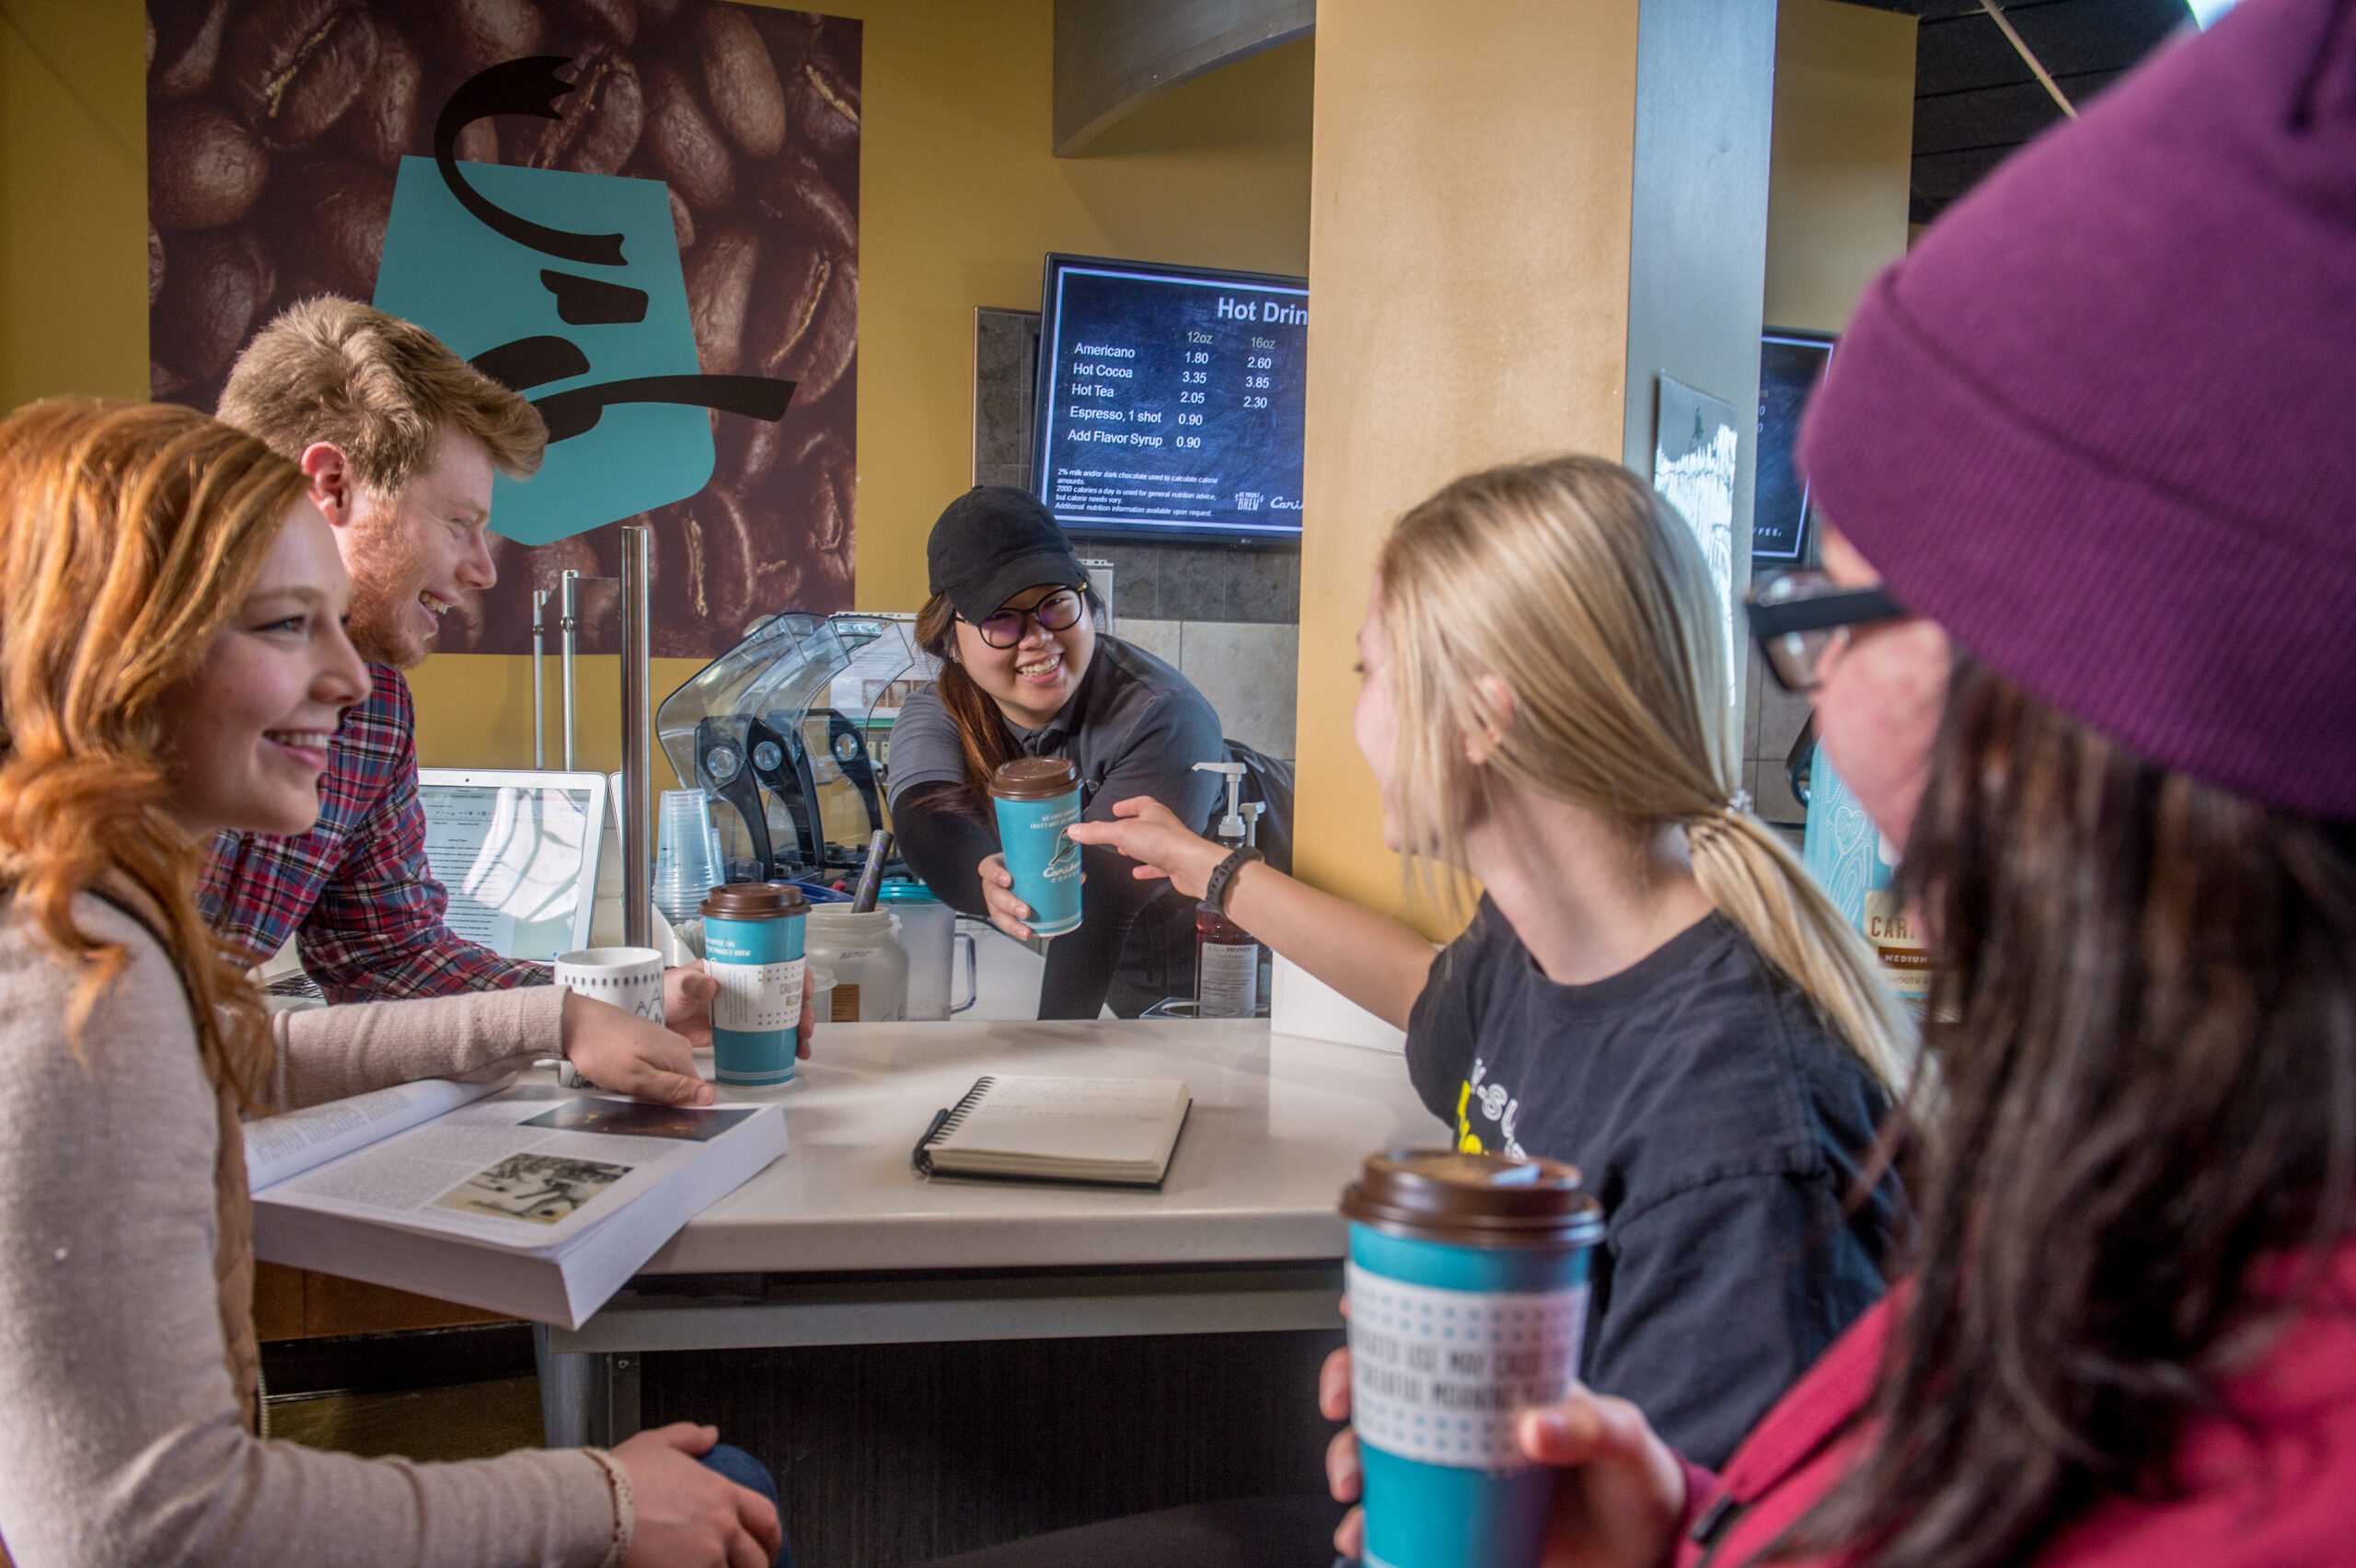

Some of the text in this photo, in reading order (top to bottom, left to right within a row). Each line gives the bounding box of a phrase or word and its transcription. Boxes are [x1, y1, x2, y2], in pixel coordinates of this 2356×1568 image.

[1217, 297, 1307, 325] Hot Drin
[1186, 331, 1276, 350] 12oz 16oz
[1074, 342, 1272, 370] Americano 1.80 2.60
[1073, 363, 1270, 389] Hot Cocoa 3.35 3.85
[1071, 384, 1268, 409] Hot Tea 2.05 2.30
[1069, 406, 1204, 426] Espresso, 1 shot 0.90
[1068, 429, 1201, 448] Add Flavor Syrup 0.90
[1057, 468, 1068, 477] 2%
[1118, 472, 1148, 481] chocolate
[1171, 475, 1197, 483] calculate
[1103, 487, 1115, 496] day
[1148, 490, 1171, 499] general
[1172, 491, 1195, 500] nutrition
[1270, 496, 1304, 510] Cari
[1055, 502, 1085, 510] Additional
[1087, 503, 1111, 512] nutrition
[1112, 504, 1145, 513] information
[1146, 506, 1172, 514] available
[1238, 498, 1260, 511] BREW
[1871, 916, 1915, 940] CARI
[1885, 954, 1928, 963] MEDIUM
[1887, 976, 1920, 986] MOOTH
